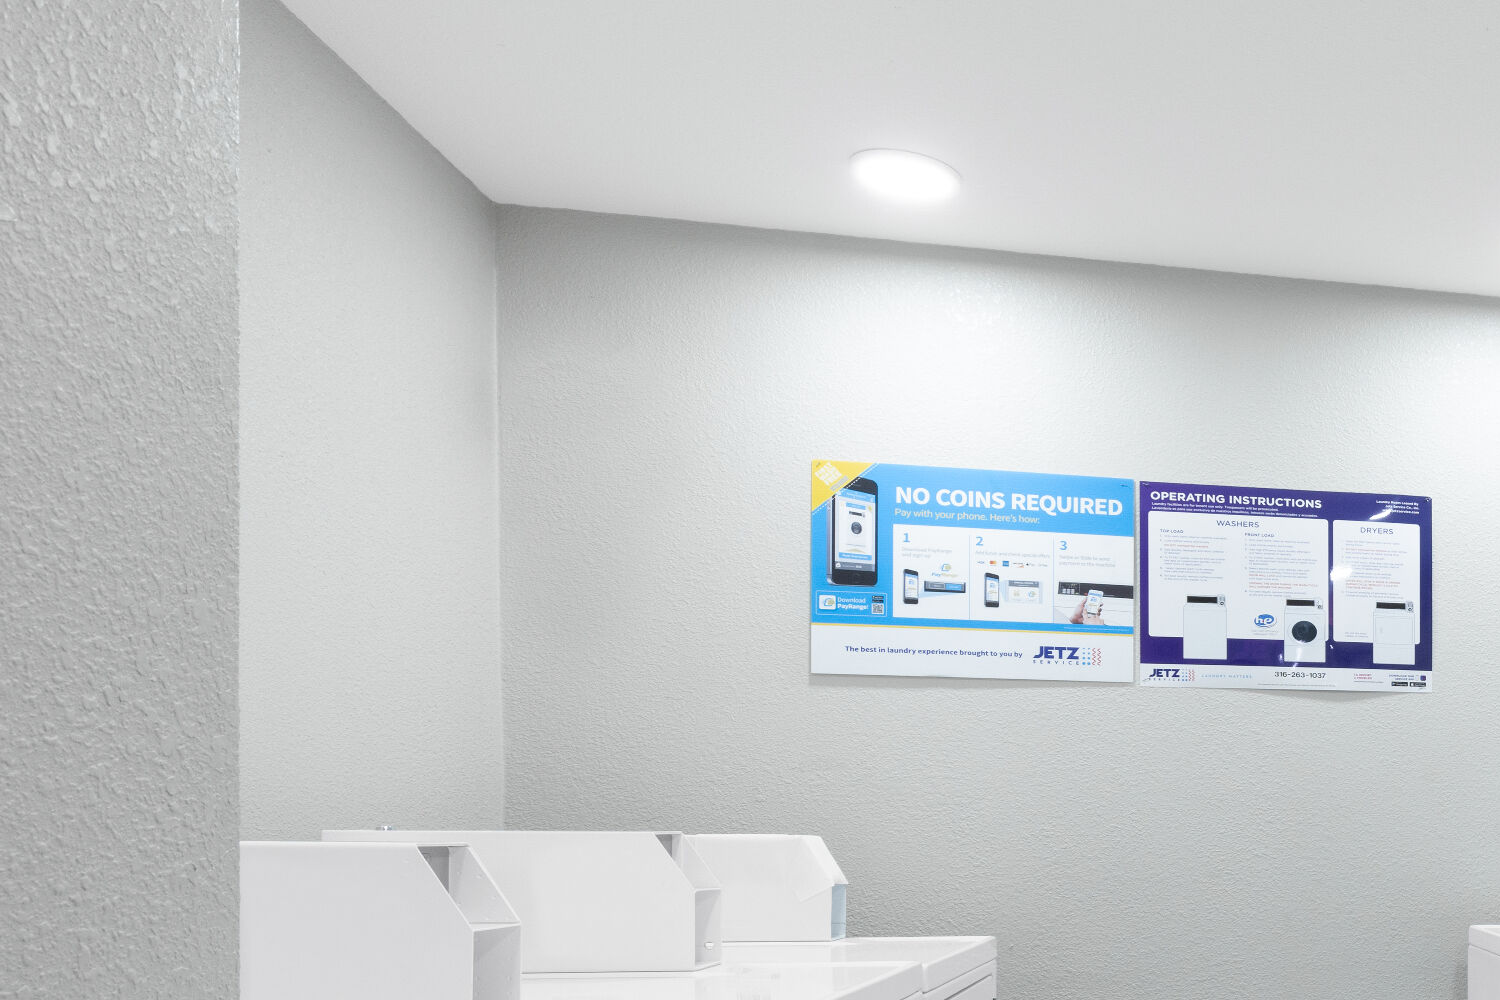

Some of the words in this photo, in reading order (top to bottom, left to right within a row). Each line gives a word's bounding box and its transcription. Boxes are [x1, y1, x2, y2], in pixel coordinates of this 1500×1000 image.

[896, 486, 930, 505] NO
[935, 488, 1006, 510] COINS
[1011, 493, 1123, 516] REQUIRED
[1150, 491, 1225, 504] OPERATING
[1229, 495, 1322, 509] INSTRUCTIONS
[894, 508, 912, 519] Pay
[913, 509, 933, 518] with
[935, 511, 955, 520] your
[957, 512, 987, 521] phone.
[989, 513, 1017, 522] Here's
[1019, 514, 1040, 524] how:
[1216, 520, 1260, 528] WASHERS
[1360, 526, 1394, 535] DRYERS
[903, 532, 911, 543] 1
[975, 536, 984, 547] 2
[1058, 540, 1068, 551] 3
[887, 647, 916, 655] laundry
[917, 648, 958, 656] experience
[960, 649, 988, 657] brought
[1033, 646, 1080, 660] JETZ
[1149, 668, 1180, 678] JETZ
[1274, 671, 1326, 679] 316-263-1037
